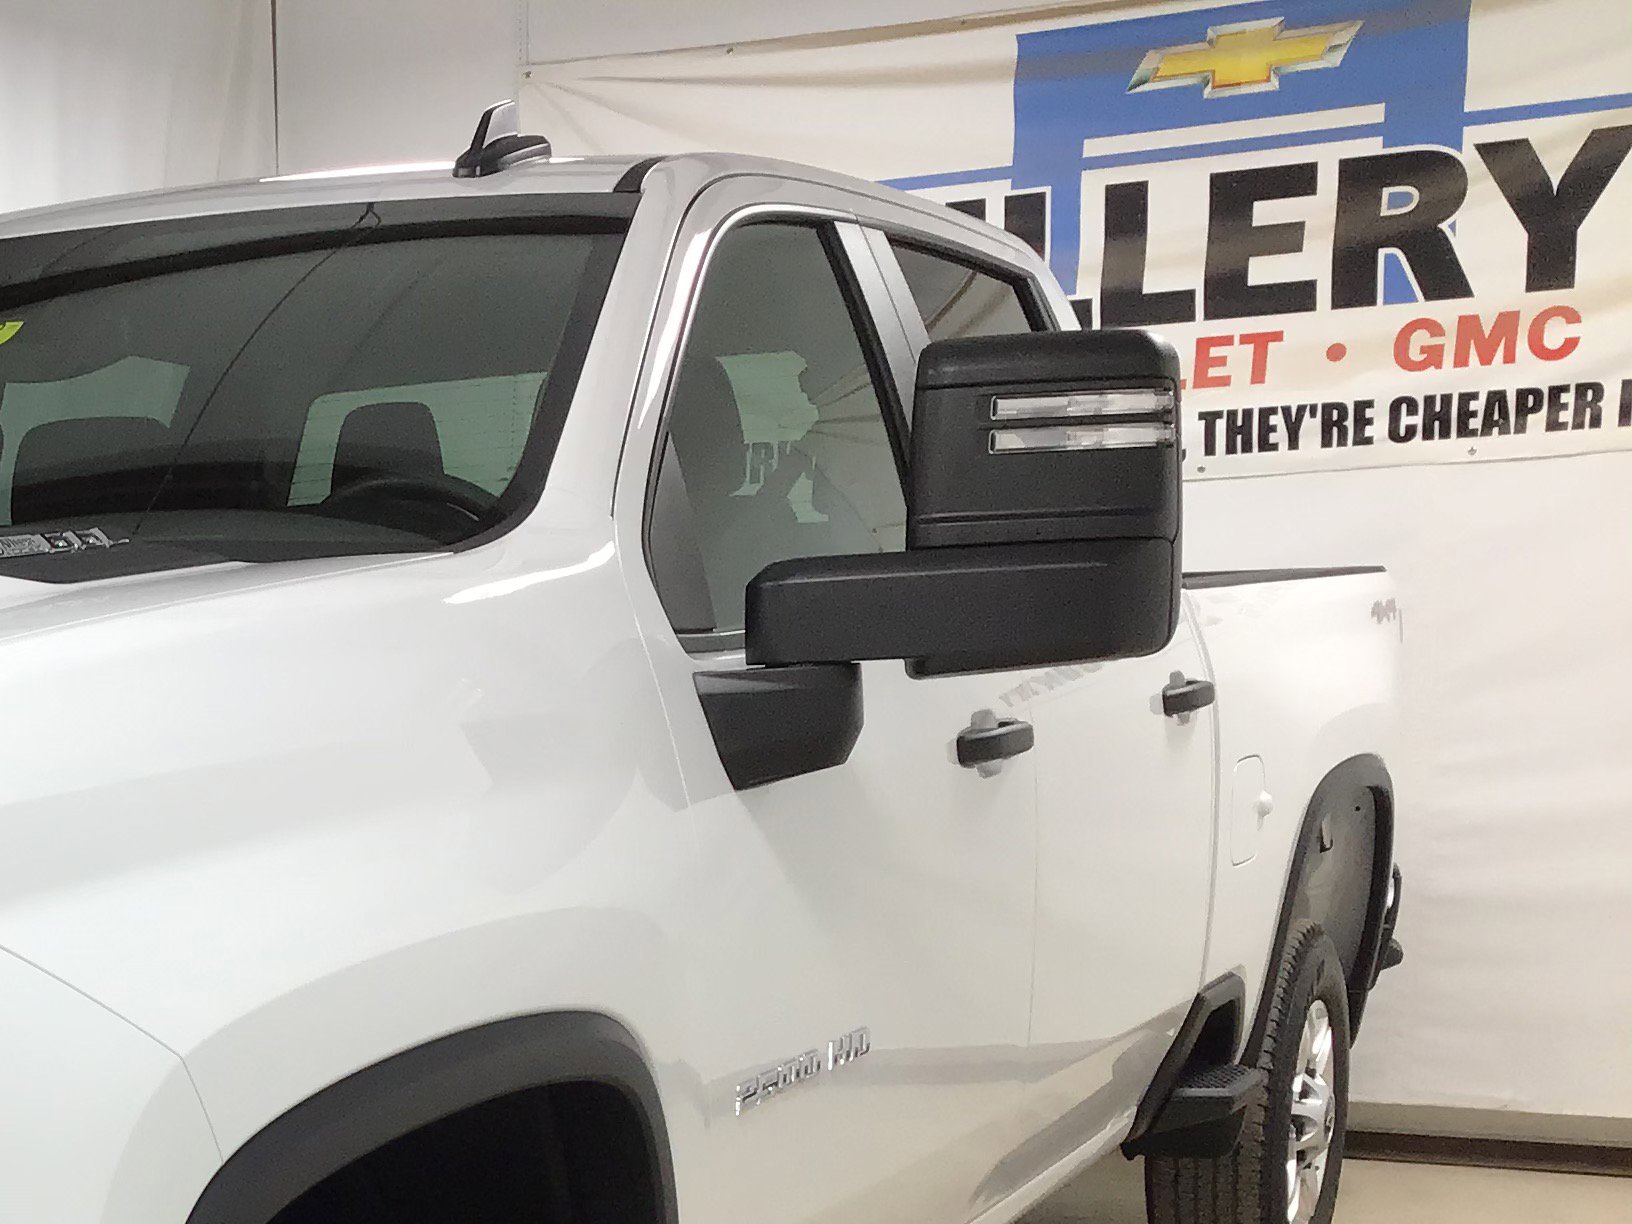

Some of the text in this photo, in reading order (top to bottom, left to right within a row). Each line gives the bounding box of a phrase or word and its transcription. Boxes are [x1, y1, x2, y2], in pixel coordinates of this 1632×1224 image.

[945, 124, 1632, 331] LERY
[1181, 305, 1582, 391] ET GMC
[1198, 399, 1375, 457] THEY'RE
[1387, 381, 1605, 444] CHEAPER
